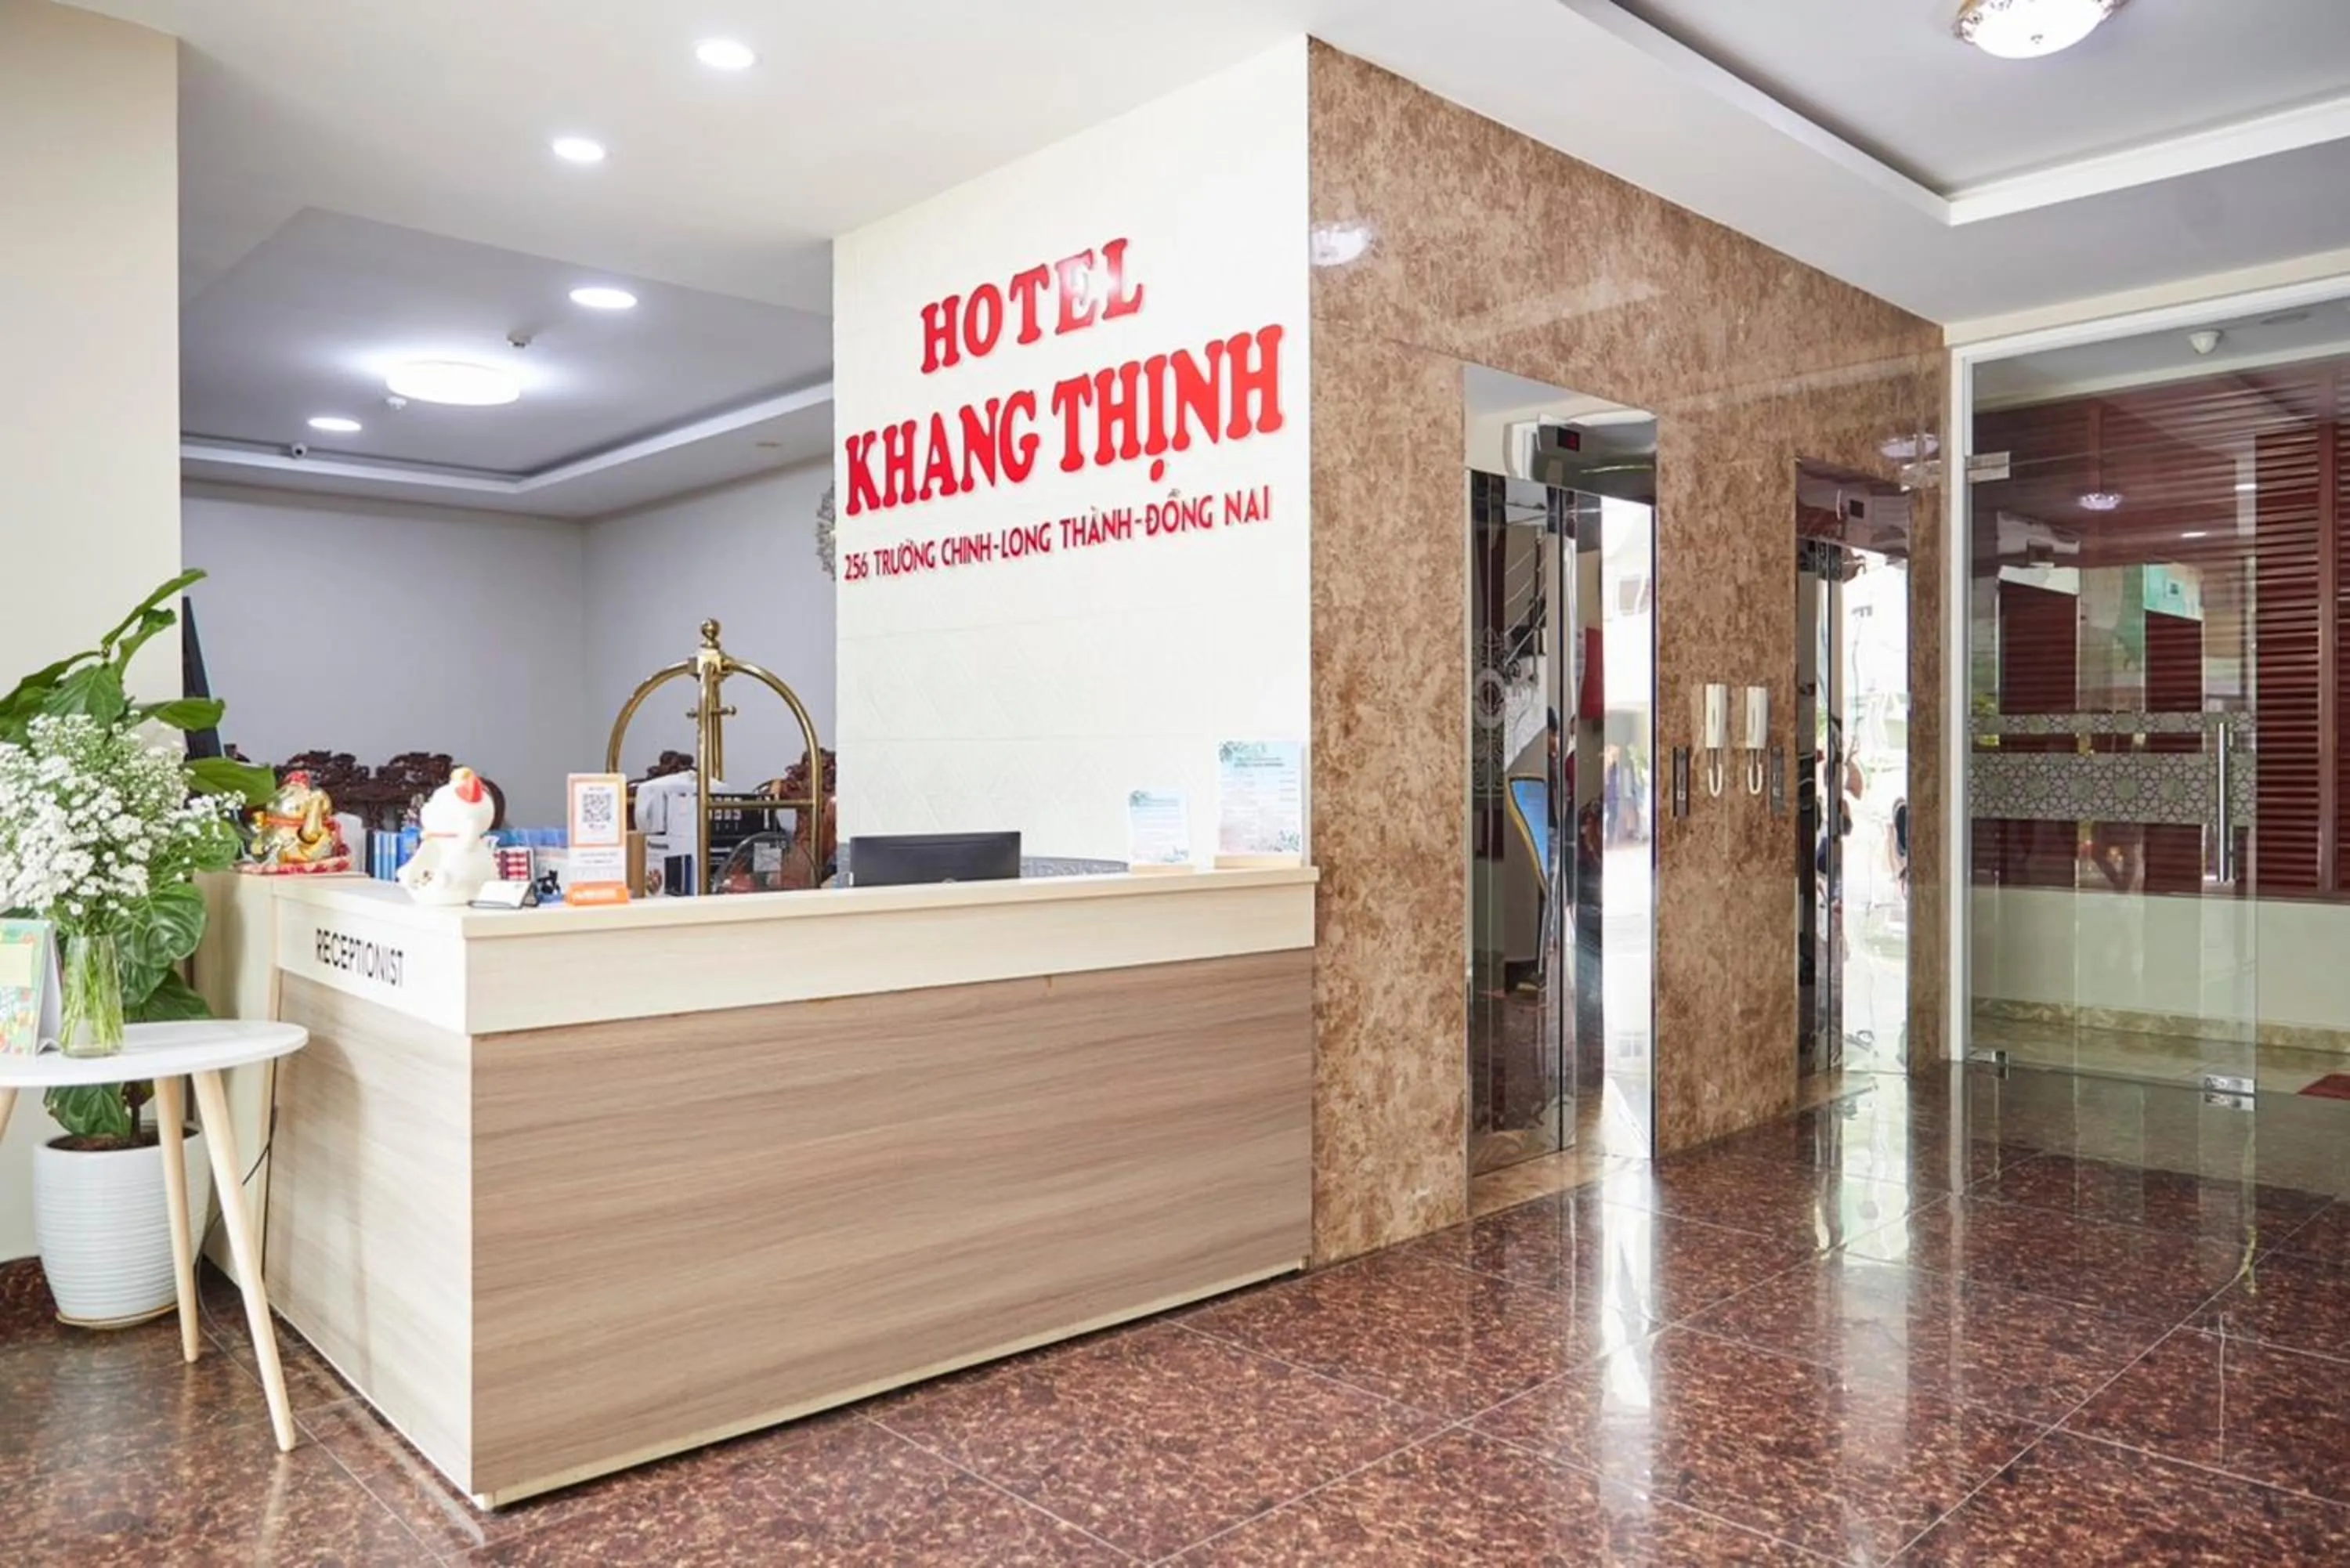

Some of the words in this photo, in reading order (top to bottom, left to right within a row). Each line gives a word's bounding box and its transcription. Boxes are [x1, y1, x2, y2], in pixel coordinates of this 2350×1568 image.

[920, 237, 1144, 374] HOTEL
[844, 389, 1041, 517] KHANG
[1050, 323, 1284, 483] THỊNH
[844, 552, 869, 581] 256
[1224, 485, 1269, 526] NAI
[315, 927, 403, 988] RECEPTIONIST
